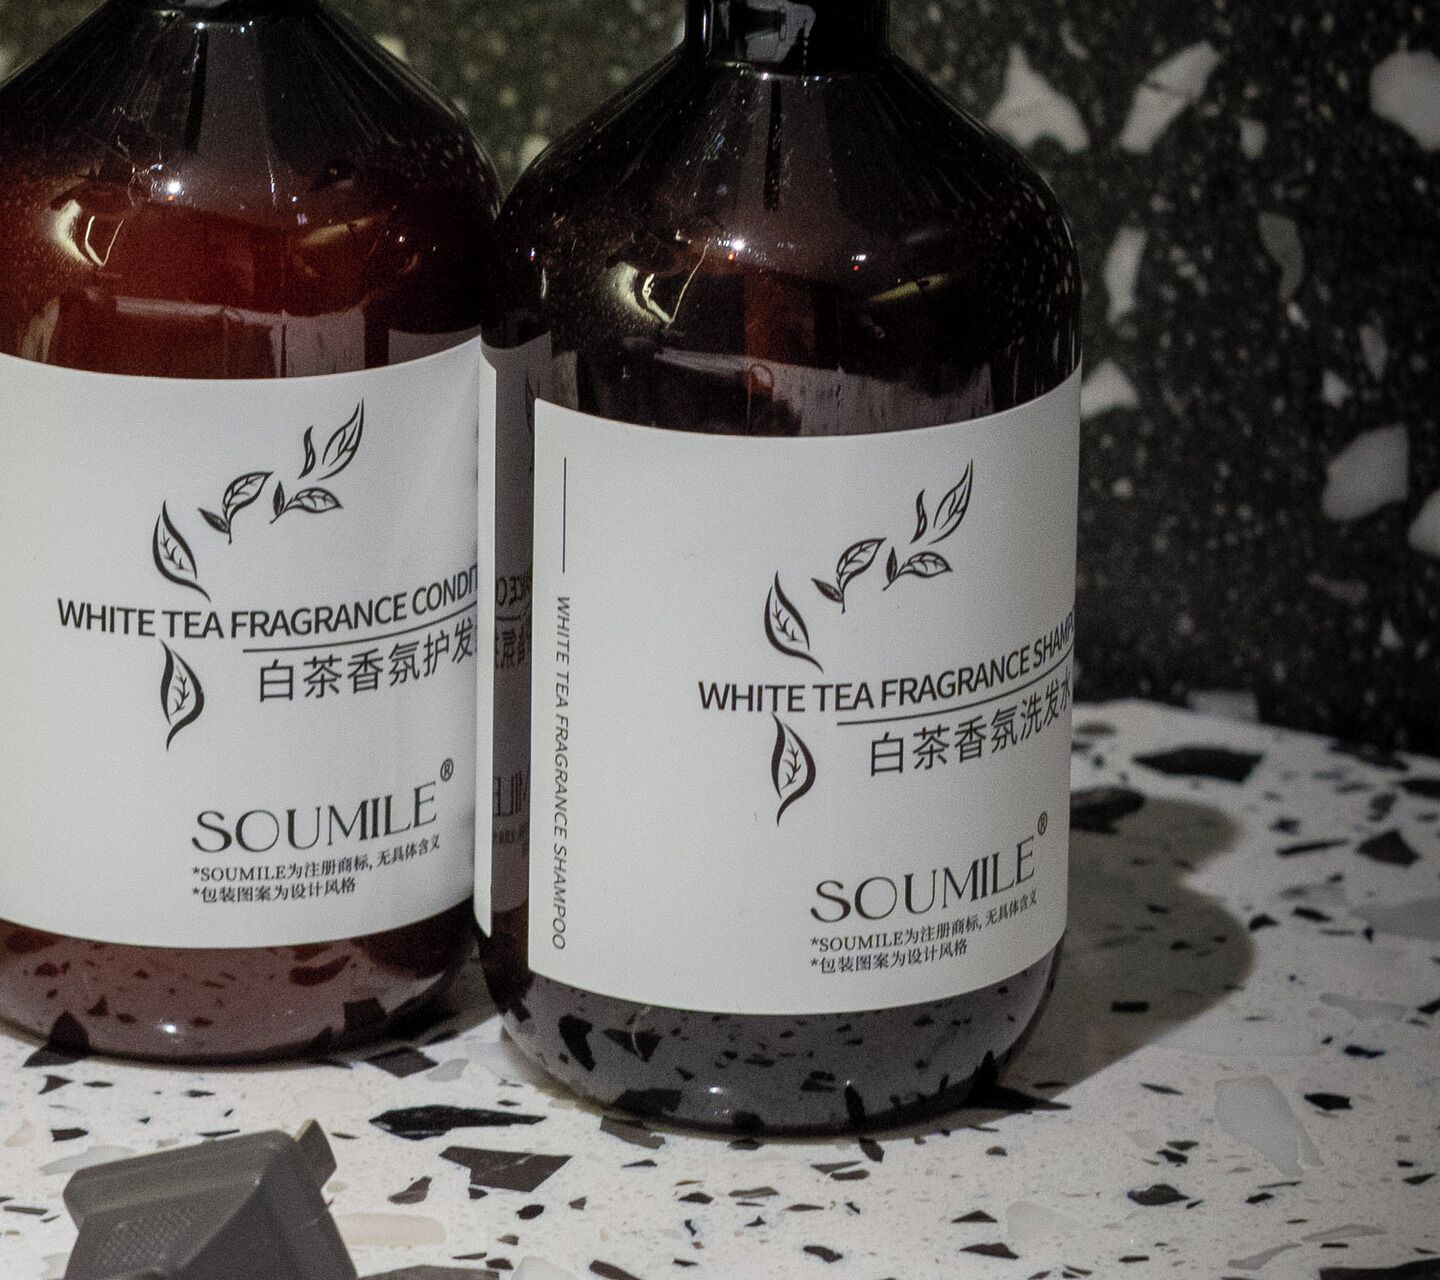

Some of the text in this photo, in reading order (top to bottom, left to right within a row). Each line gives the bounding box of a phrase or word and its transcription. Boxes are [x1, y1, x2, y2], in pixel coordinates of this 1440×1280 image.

[57, 597, 155, 638] WHITE
[162, 609, 224, 639] TEA
[231, 592, 408, 639] FRAGRANCE
[259, 616, 478, 702] 白茶香氛护发
[698, 680, 806, 713] WHITE
[812, 681, 875, 712] TEA
[881, 644, 1031, 709] FRAGRANCE
[870, 665, 1072, 777] 白茶香氛洗发水
[552, 596, 570, 951] WHITE TEA FRAGRANCE SHAMPOO
